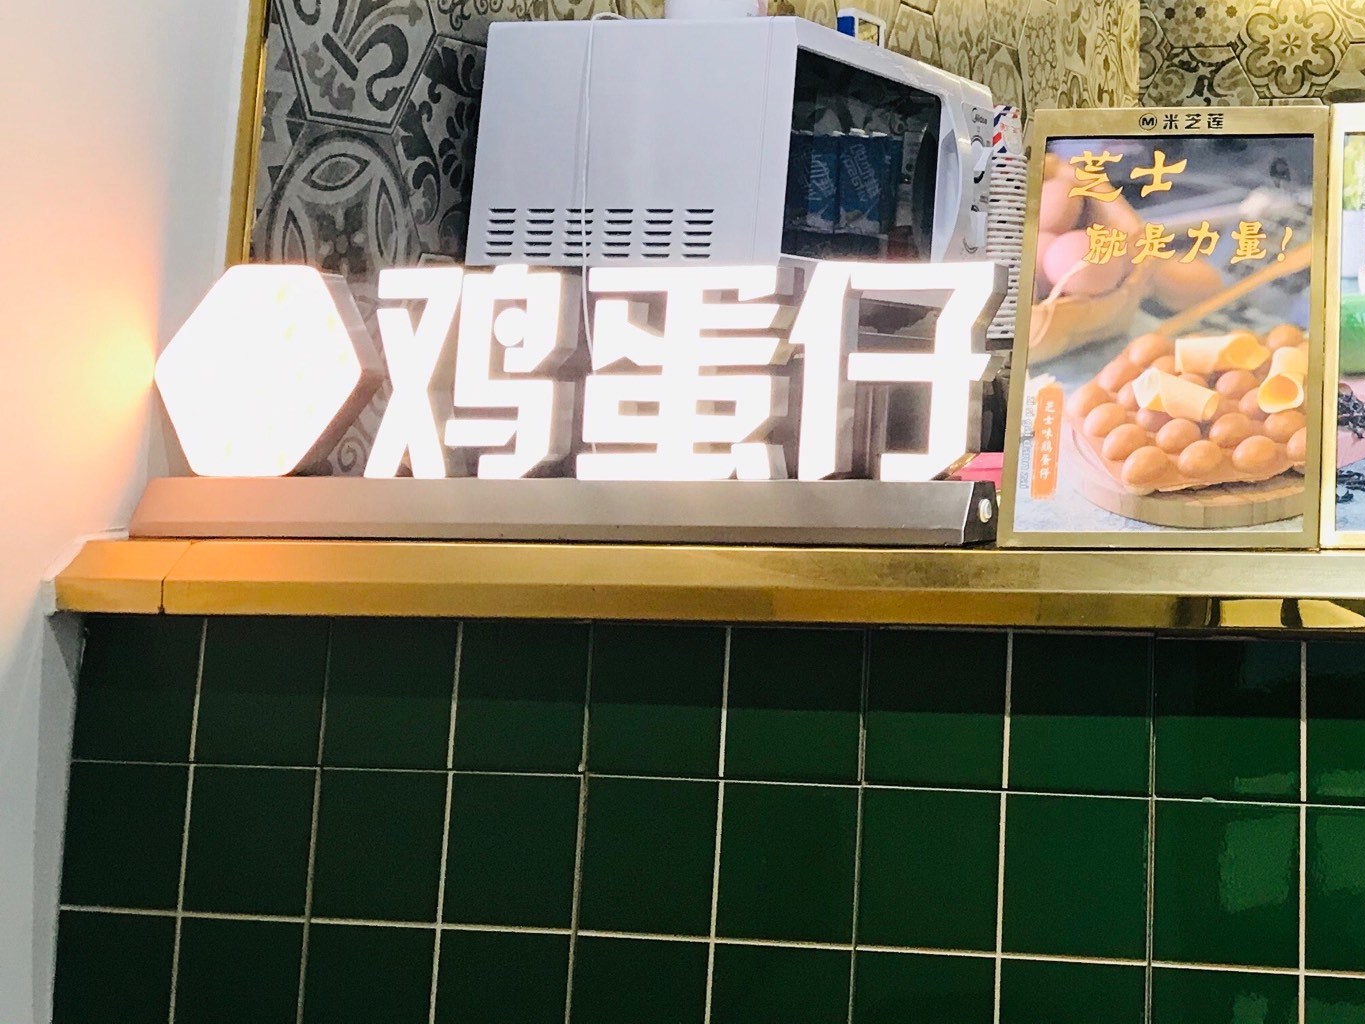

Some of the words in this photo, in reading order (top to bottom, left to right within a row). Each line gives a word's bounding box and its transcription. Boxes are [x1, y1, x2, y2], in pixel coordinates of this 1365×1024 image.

[1163, 113, 1224, 130] 米芝莲
[1068, 150, 1188, 202] 芝士
[366, 261, 998, 481] 鸡蛋仔
